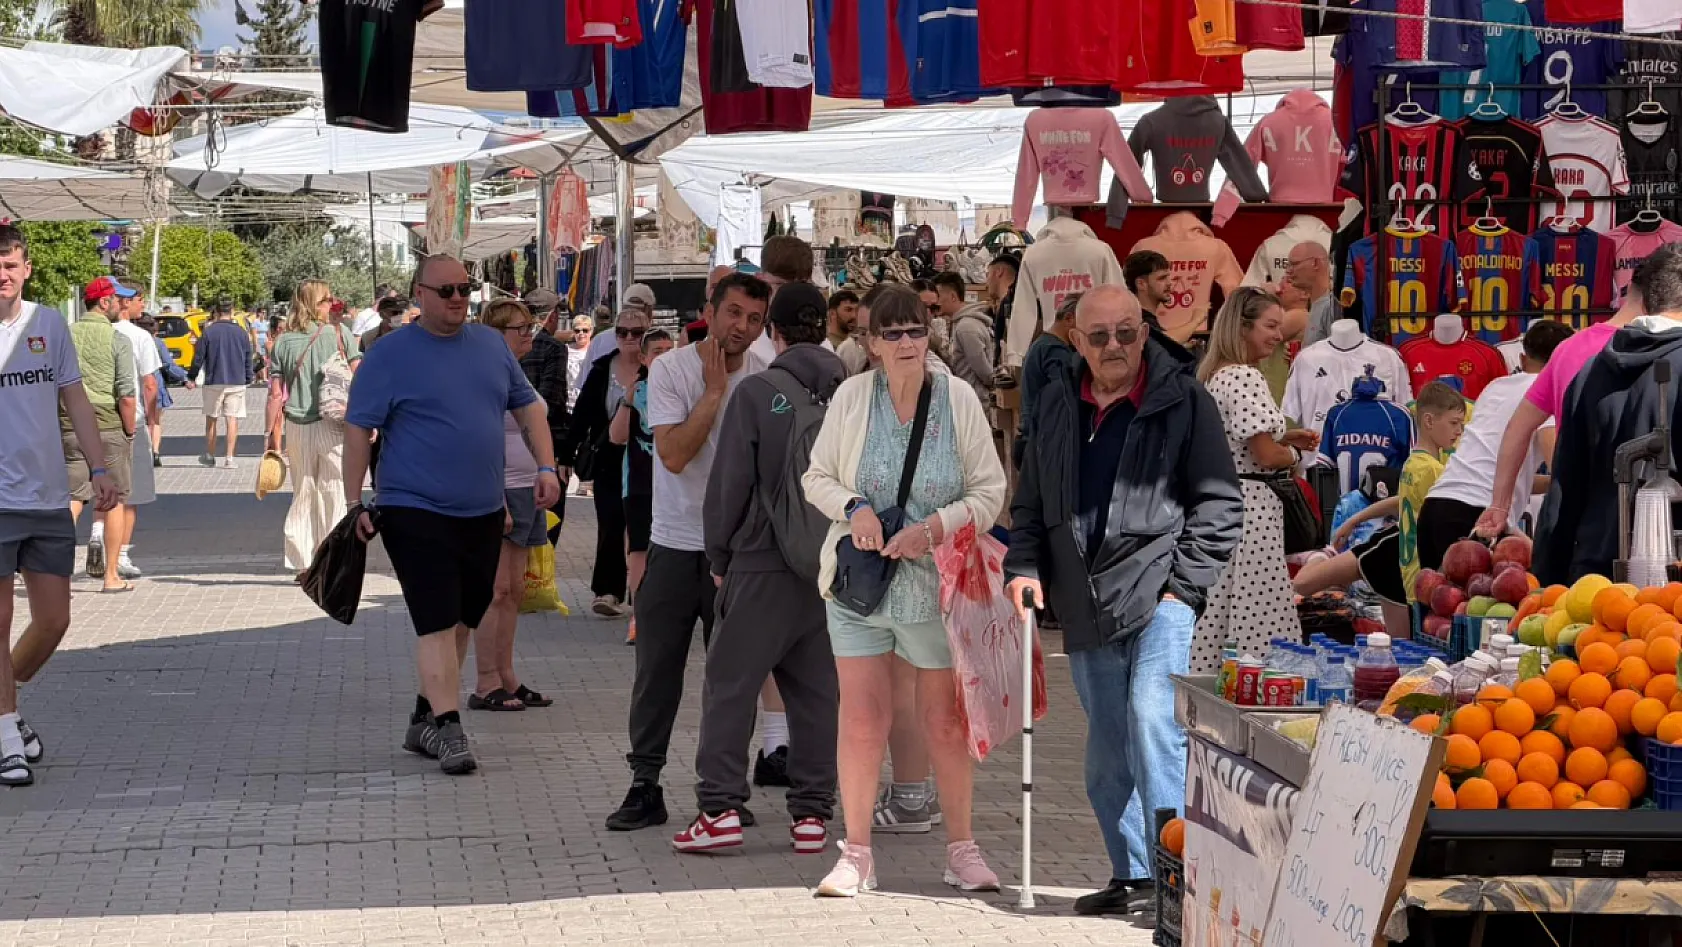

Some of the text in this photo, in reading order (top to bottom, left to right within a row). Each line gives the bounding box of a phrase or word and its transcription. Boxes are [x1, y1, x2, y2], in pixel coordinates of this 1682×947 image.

[1544, 51, 1573, 110] 9
[1398, 155, 1427, 171] KAKA
[1554, 168, 1585, 185] KAKA
[1168, 260, 1208, 272] ITE FOX
[1389, 257, 1426, 273] MESSI
[1545, 263, 1585, 277] MESSI
[1043, 274, 1092, 293] WHITE
[1388, 279, 1428, 334] 10
[1468, 276, 1509, 332] 10
[1336, 432, 1391, 449] ZIDANE
